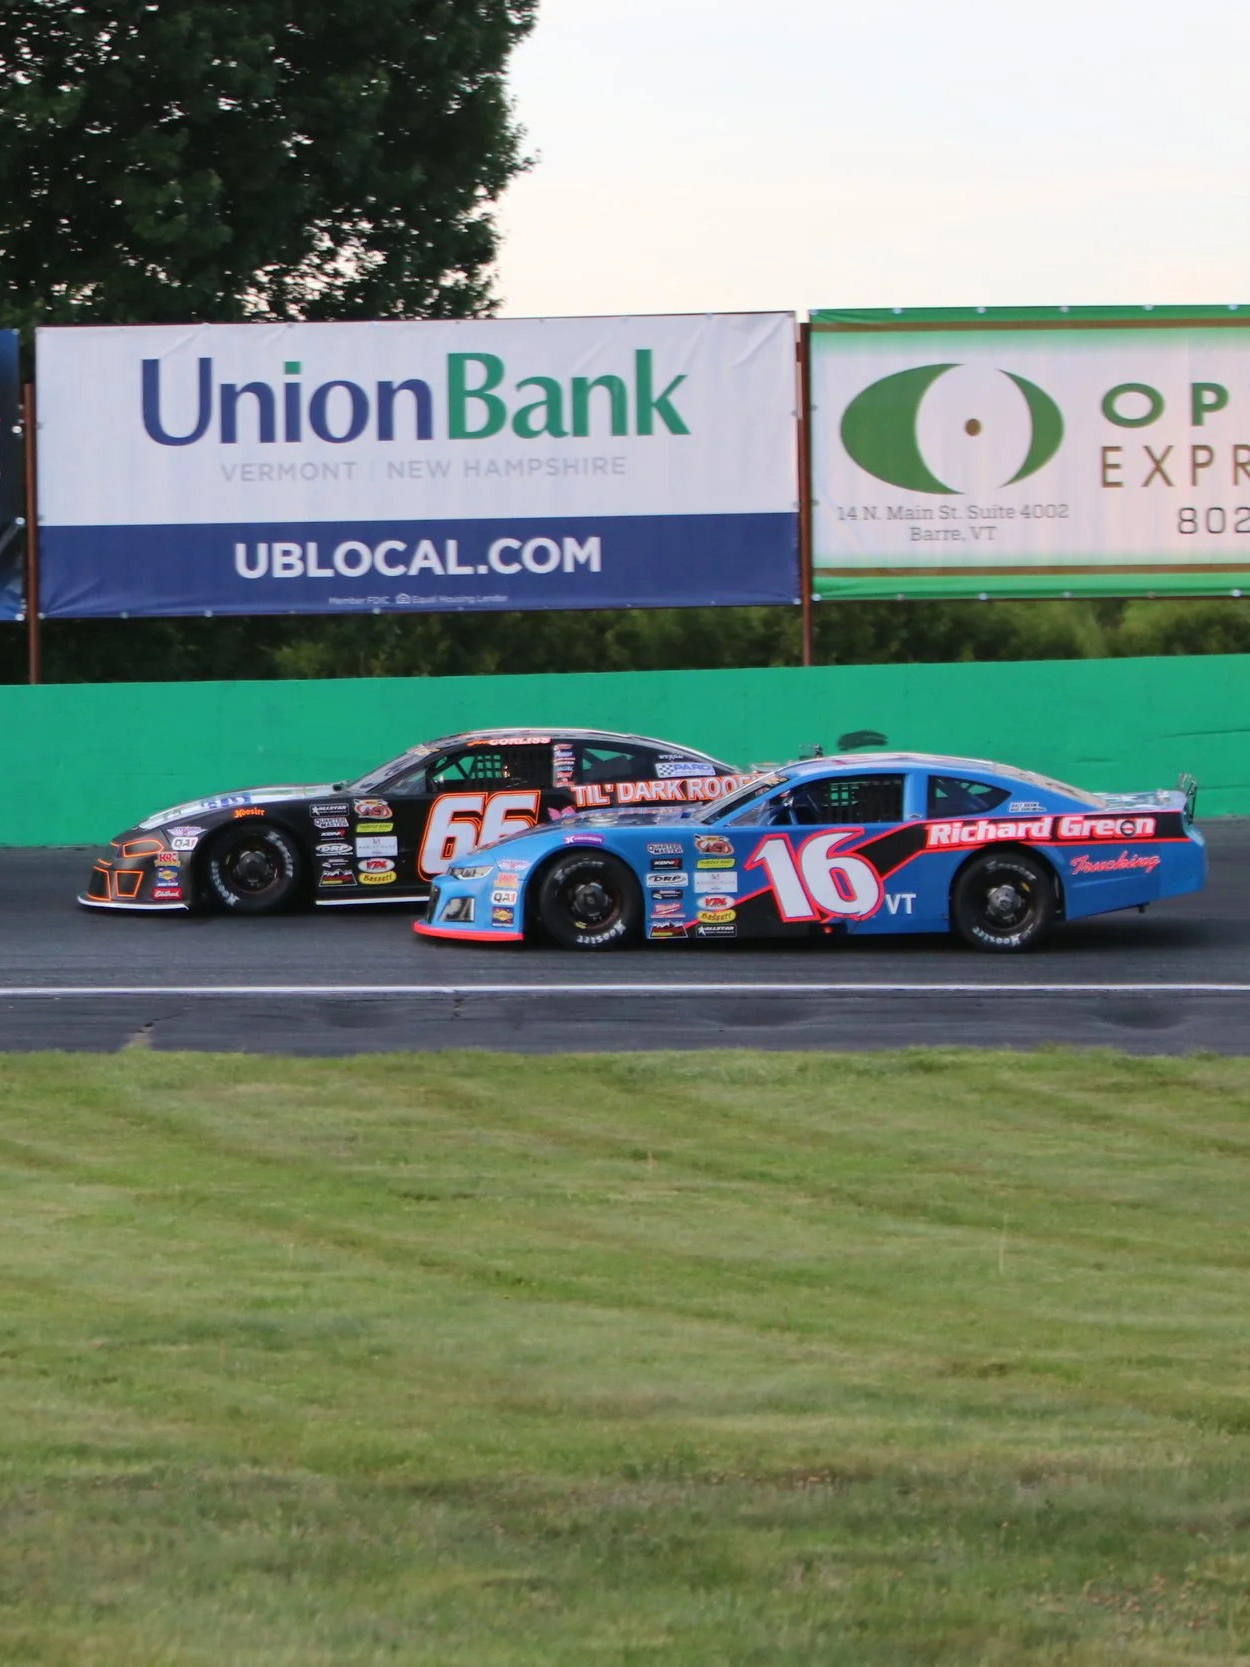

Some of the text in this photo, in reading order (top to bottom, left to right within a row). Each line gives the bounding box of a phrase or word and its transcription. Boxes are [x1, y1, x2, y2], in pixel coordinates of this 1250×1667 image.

[1100, 382, 1229, 428] OP
[220, 455, 628, 484] VERMONT NEW HAMPSHIRE
[1100, 443, 1250, 489] EXPR
[837, 503, 1070, 521] 14 N. Main St. Suite 4002
[1177, 506, 1250, 535] 802
[910, 525, 998, 542] Barre, VT
[234, 536, 602, 580] UBLOCAL.COM
[617, 778, 686, 804] DARK
[418, 789, 542, 883] 66
[924, 817, 1054, 849] Richard
[744, 827, 885, 922] 16
[1069, 850, 1162, 876] Trucking
[885, 894, 917, 915] VT
